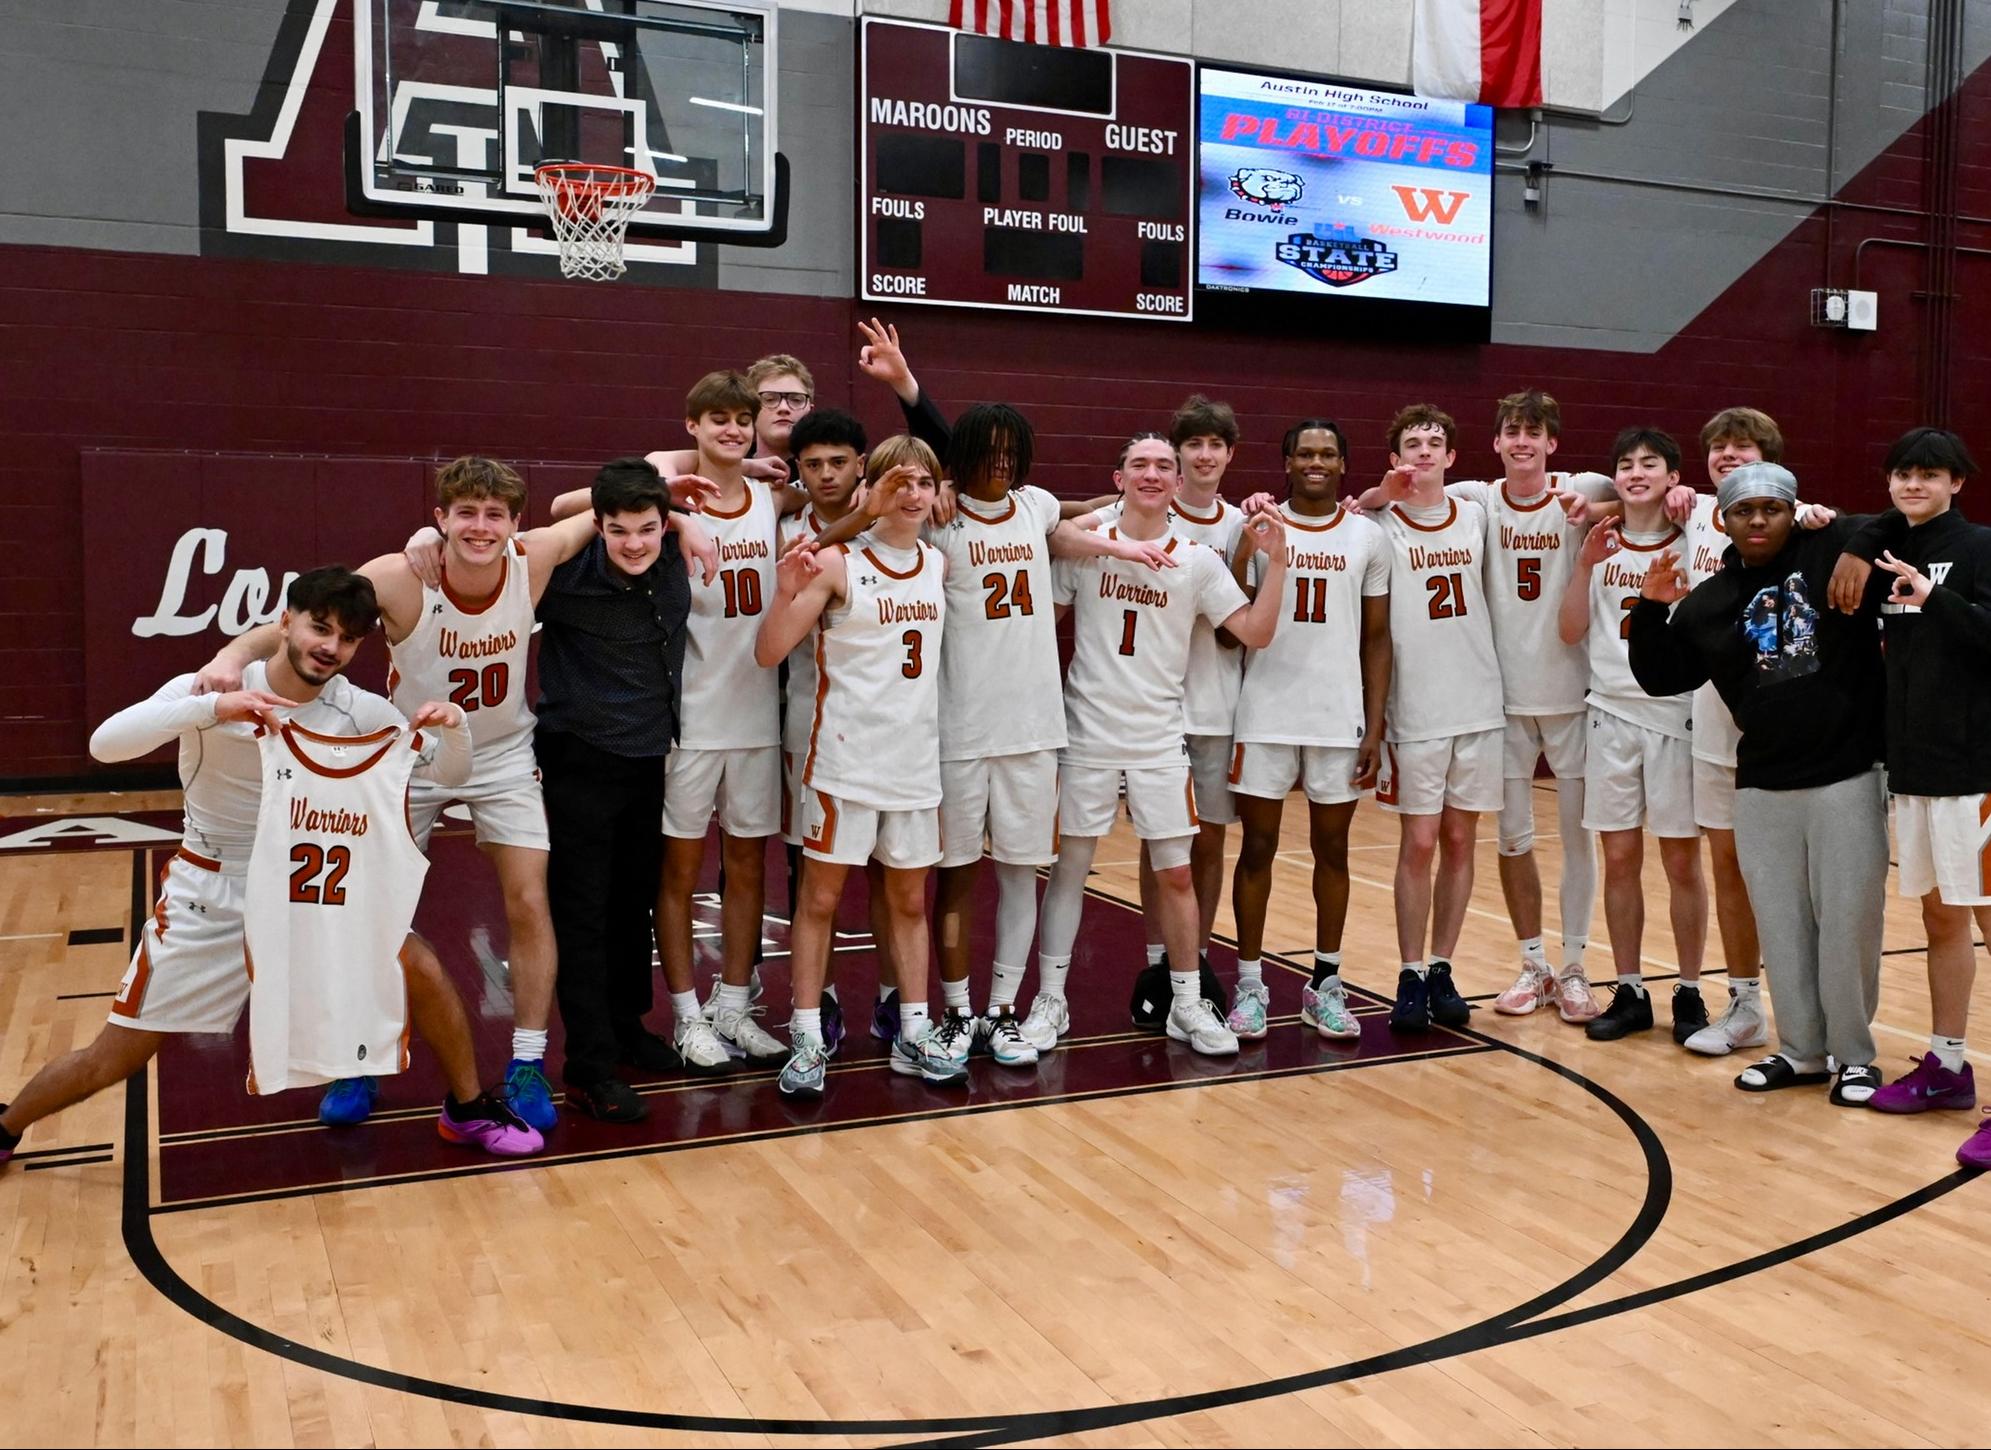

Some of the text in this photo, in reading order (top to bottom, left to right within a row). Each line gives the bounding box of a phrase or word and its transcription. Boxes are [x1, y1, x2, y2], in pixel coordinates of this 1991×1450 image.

[1260, 81, 1429, 110] Austin High School
[871, 97, 991, 135] MAROONS
[1006, 128, 1062, 150] PERIOD
[1105, 124, 1178, 155] GUEST
[1221, 113, 1478, 168] PLAYOFFS
[872, 197, 924, 220] FOULS
[1225, 208, 1298, 226] Bowie
[1391, 185, 1470, 225] W
[984, 207, 1088, 233] PLAYER FOUL
[1137, 222, 1184, 242] FOULS
[1368, 223, 1486, 245] Westwood
[1279, 243, 1395, 269] STATE
[1306, 239, 1369, 250] BASKETBALL
[1301, 261, 1374, 273] CHAMPIONSHIPS
[872, 274, 926, 295] SCORE
[1008, 284, 1060, 304] MATCH
[1136, 293, 1184, 313] SCORE
[1500, 525, 1560, 550] Warriors
[968, 540, 1033, 567] Warriors
[1409, 546, 1472, 571] Warriors
[1517, 557, 1541, 601] 5
[1604, 562, 1648, 589] Warri
[720, 568, 762, 618] 10
[982, 569, 1034, 620] 24
[1100, 572, 1167, 608] Warriors
[1293, 577, 1327, 623] 11
[1425, 573, 1467, 620] 21
[877, 597, 938, 625] Warriors
[440, 627, 516, 659] Warriors
[1119, 609, 1138, 656] 1
[902, 629, 922, 679] 3
[448, 662, 508, 712] 20
[290, 797, 368, 837] Warriors
[289, 843, 350, 905] 22
